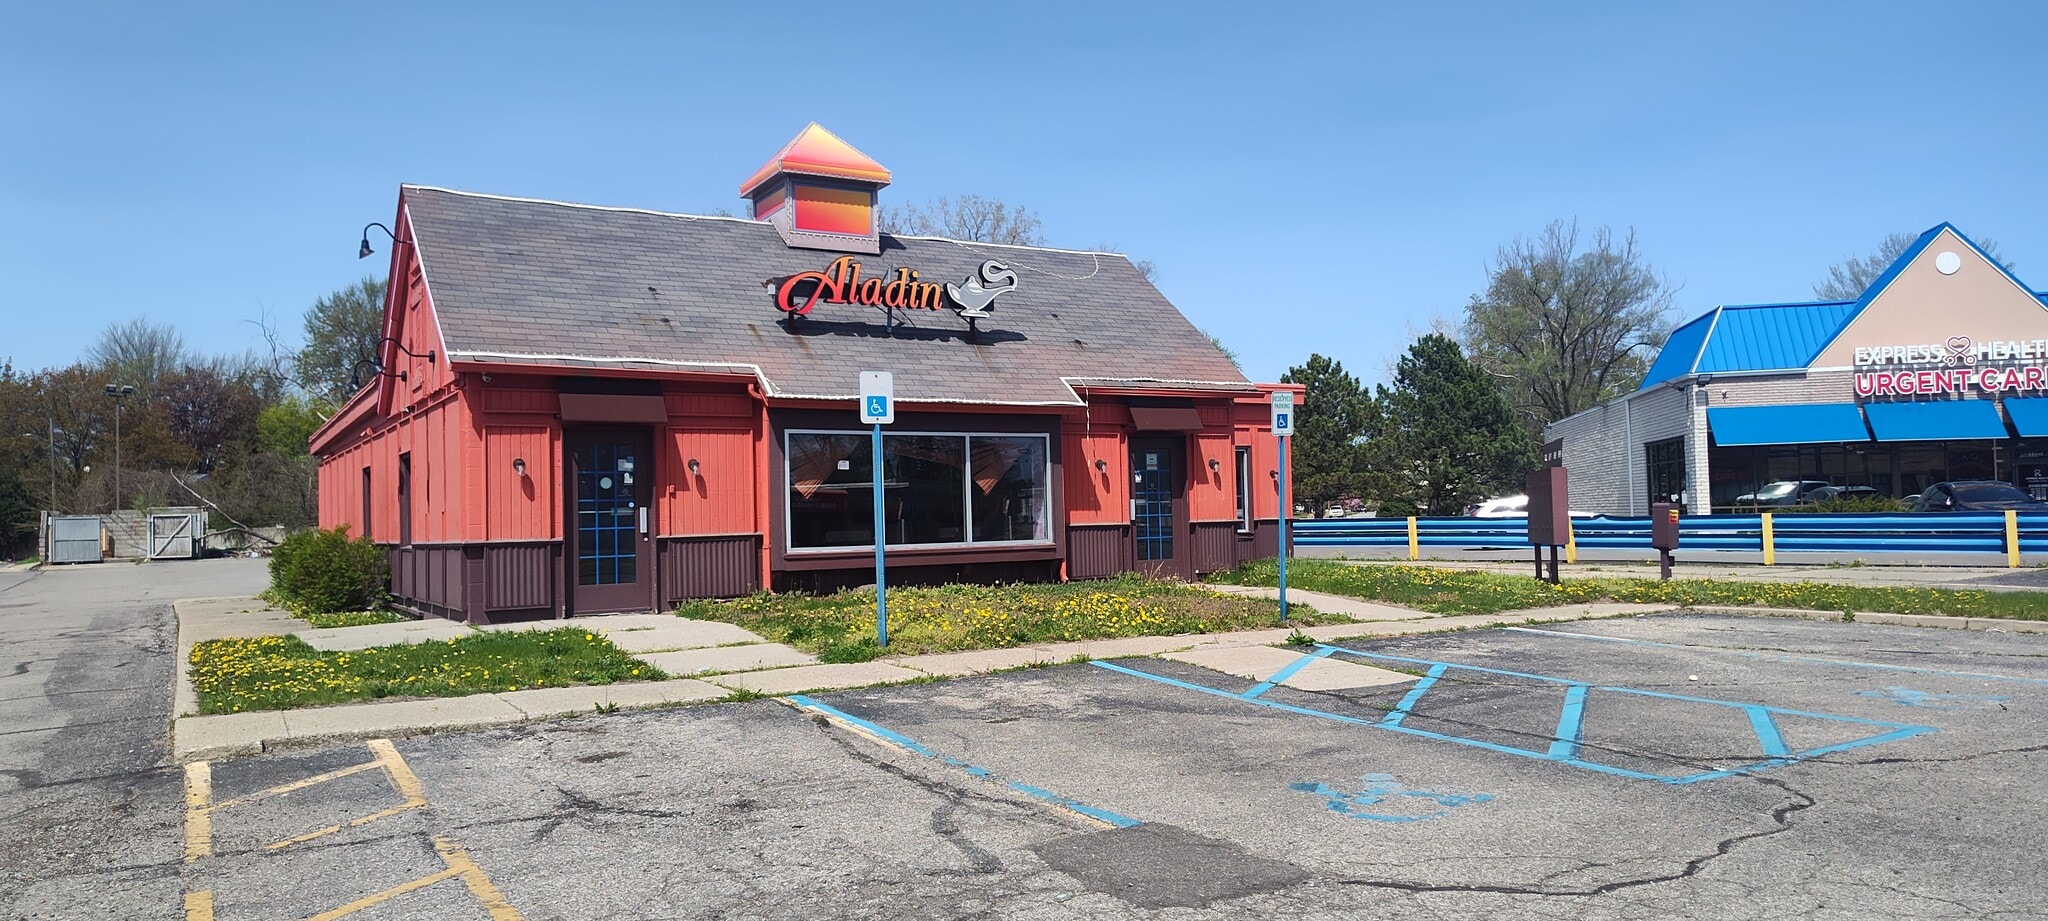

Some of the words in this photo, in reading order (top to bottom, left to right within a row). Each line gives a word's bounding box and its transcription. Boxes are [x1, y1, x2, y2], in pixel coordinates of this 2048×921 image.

[777, 255, 942, 315] Aladin
[1855, 344, 1943, 365] EXPRESS
[1977, 339, 2048, 360] HEALT
[1855, 369, 1973, 396] URGENT
[1979, 366, 2048, 391] CAR
